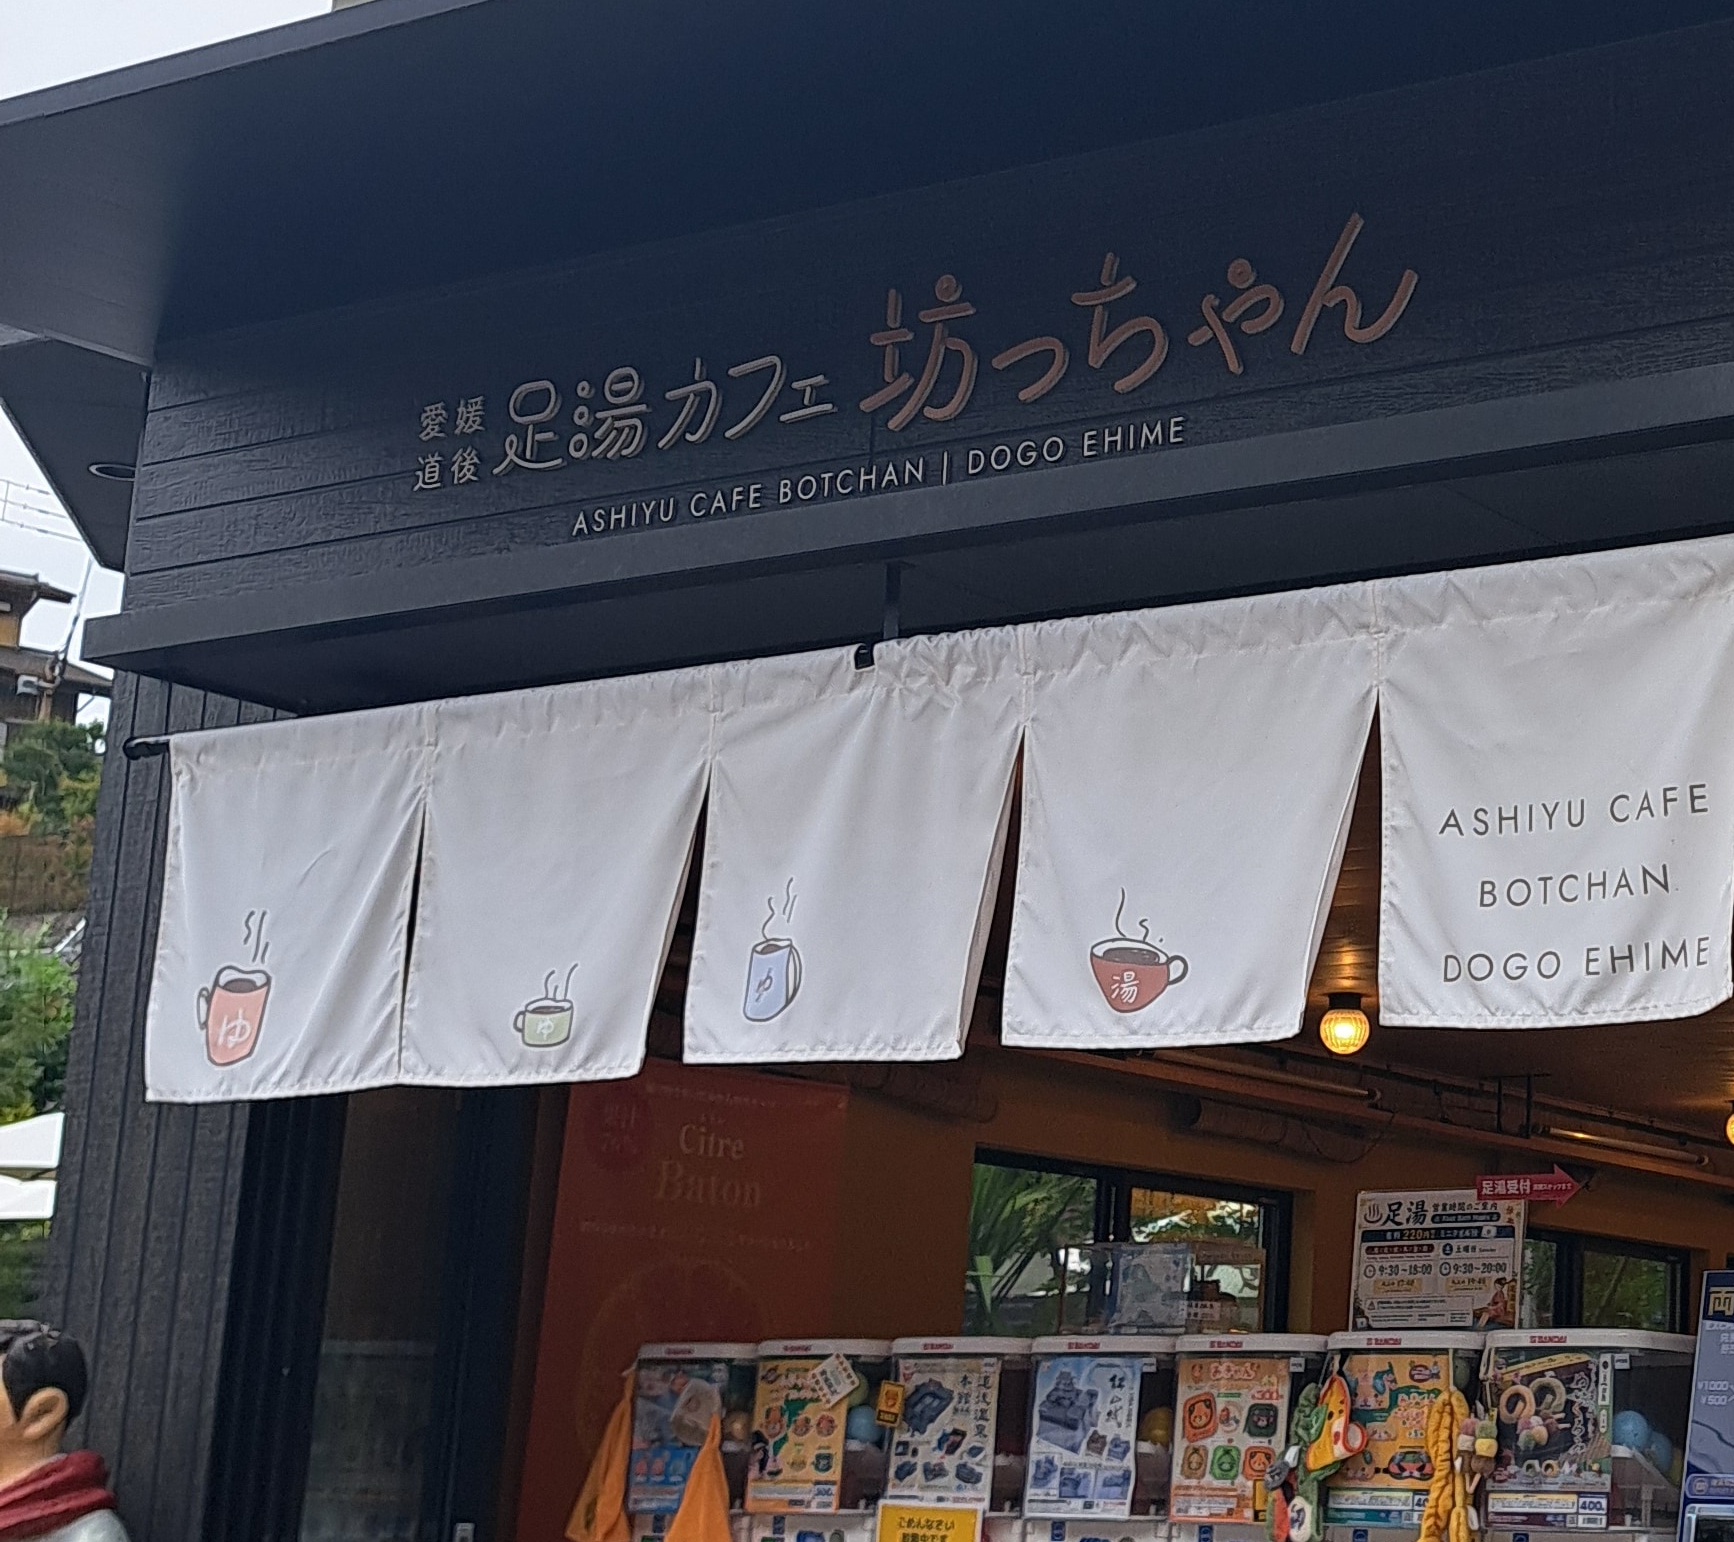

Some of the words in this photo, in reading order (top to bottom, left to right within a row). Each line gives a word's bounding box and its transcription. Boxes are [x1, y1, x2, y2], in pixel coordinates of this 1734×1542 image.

[490, 354, 837, 476] 足湯カフェ
[859, 213, 1420, 433] 坊っちゃん
[418, 395, 488, 441] 愛媛
[412, 450, 484, 493] 道後
[571, 490, 676, 537] ASHIYU
[689, 480, 764, 516] CAFE
[777, 456, 924, 507] BOTCHAN
[967, 435, 1066, 476] DOGO
[1081, 416, 1187, 460] EHIME
[1438, 797, 1586, 837] ASHIYU
[1609, 783, 1710, 824] CAFE
[1479, 863, 1671, 908] BOTCHAN
[1443, 950, 1562, 983] DOGO
[1584, 936, 1711, 977] EHIME
[1111, 970, 1140, 1004] 湯
[1381, 1200, 1429, 1226] 足湯
